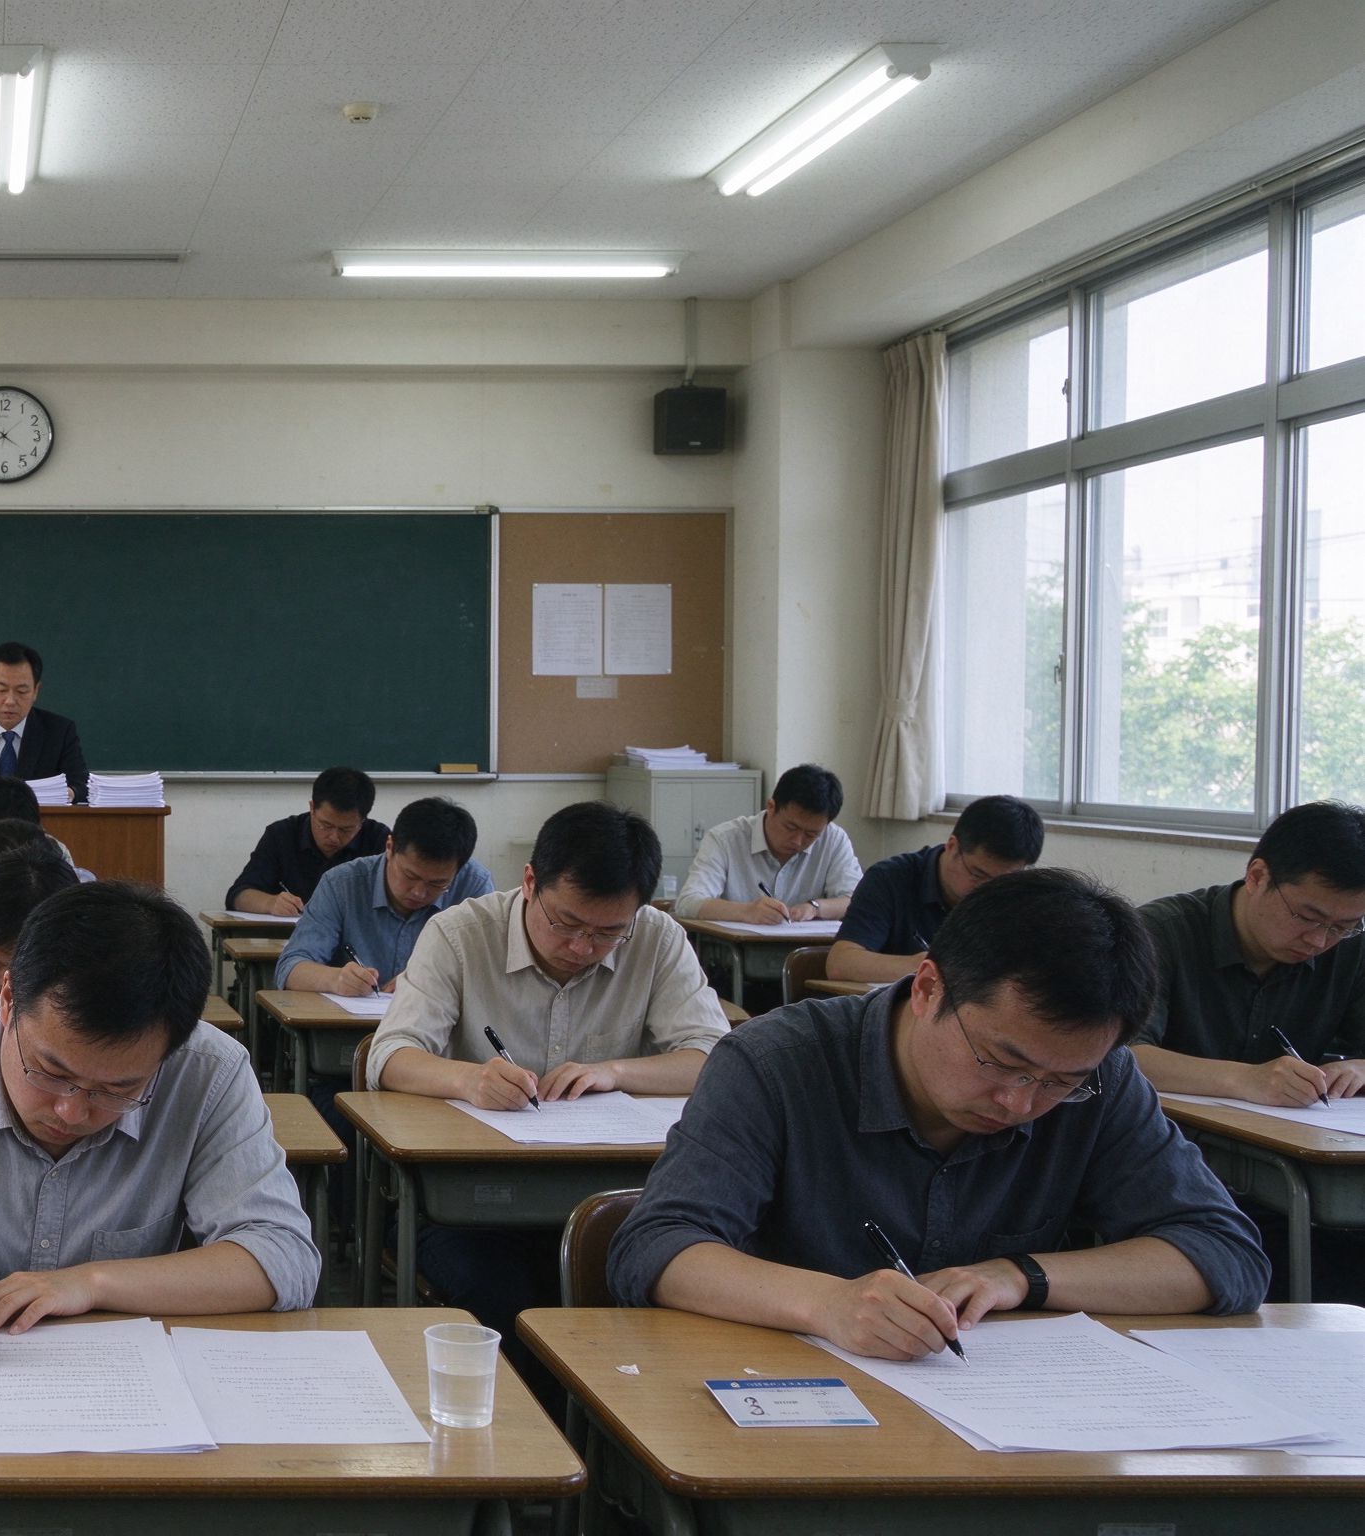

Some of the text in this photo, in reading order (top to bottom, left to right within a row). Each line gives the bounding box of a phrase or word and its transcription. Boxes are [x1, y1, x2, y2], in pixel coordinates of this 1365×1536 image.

[0, 399, 11, 411] 12
[20, 403, 24, 414] 1
[30, 414, 39, 426] 2
[33, 430, 41, 442] 3
[30, 447, 37, 457] 4
[1, 461, 9, 473] 6
[18, 455, 27, 467] 5
